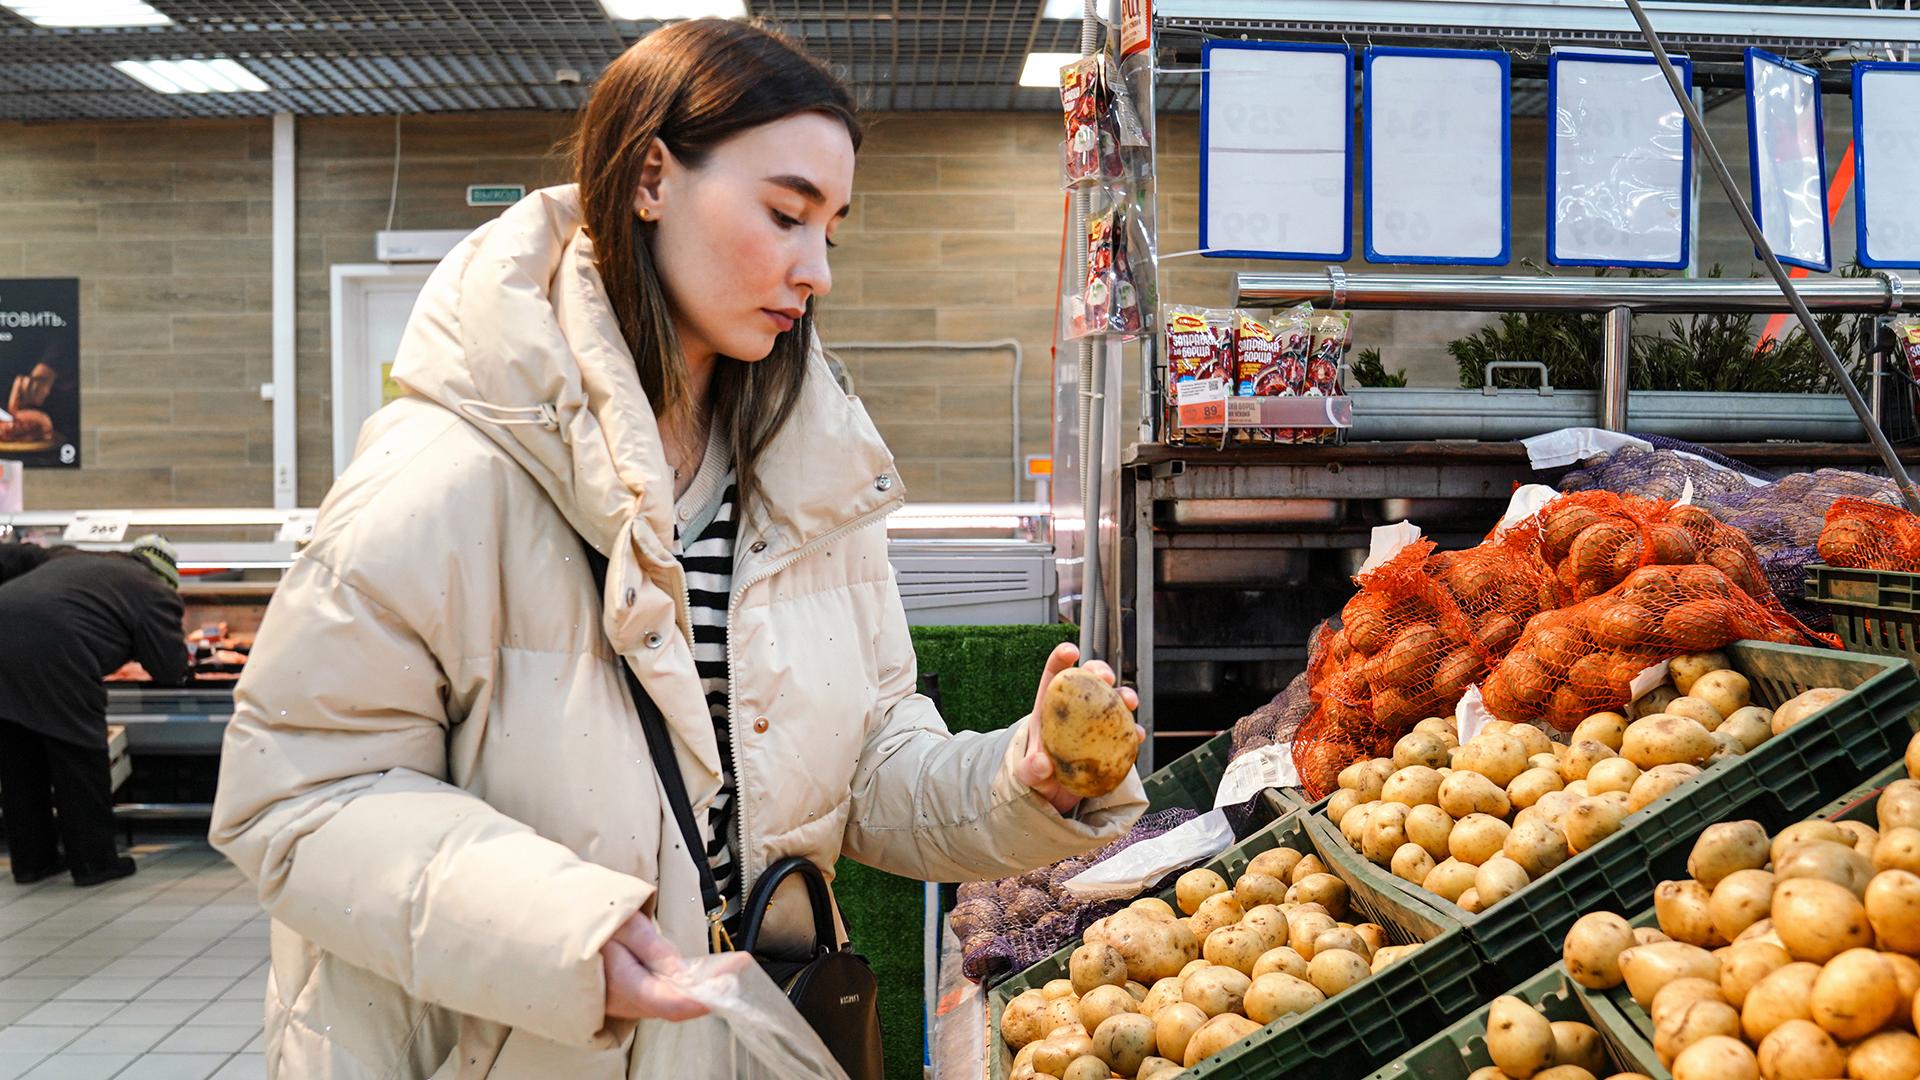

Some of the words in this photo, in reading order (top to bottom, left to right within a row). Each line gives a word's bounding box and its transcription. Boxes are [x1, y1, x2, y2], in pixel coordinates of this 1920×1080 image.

[1238, 338, 1280, 353] ЗАПРАВКА
[1182, 346, 1211, 358] БОРЩА
[1244, 351, 1272, 364] БОРЩА
[1204, 405, 1218, 416] 89
